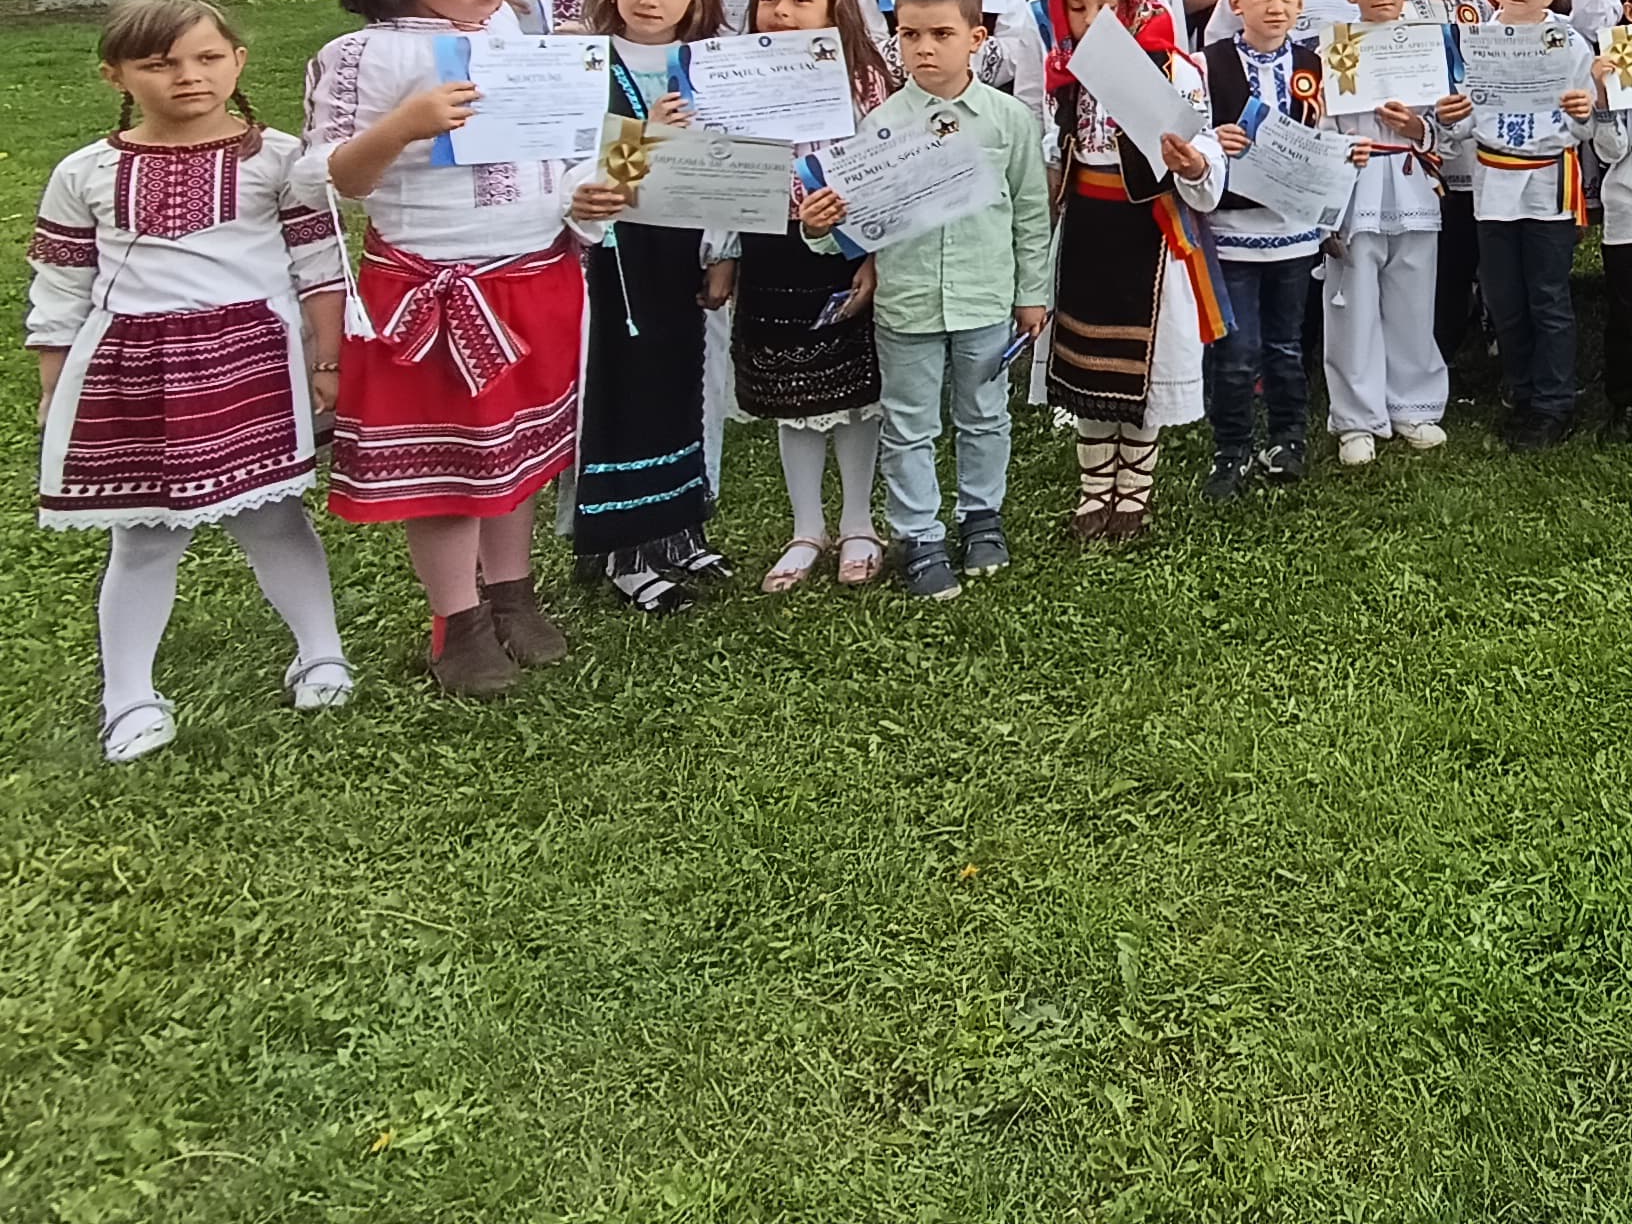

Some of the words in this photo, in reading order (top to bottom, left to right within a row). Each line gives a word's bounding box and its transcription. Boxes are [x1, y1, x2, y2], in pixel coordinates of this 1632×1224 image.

[708, 67, 767, 80] PREMIUL
[769, 60, 822, 74] SPECIAL
[843, 159, 898, 186] PREMIUL
